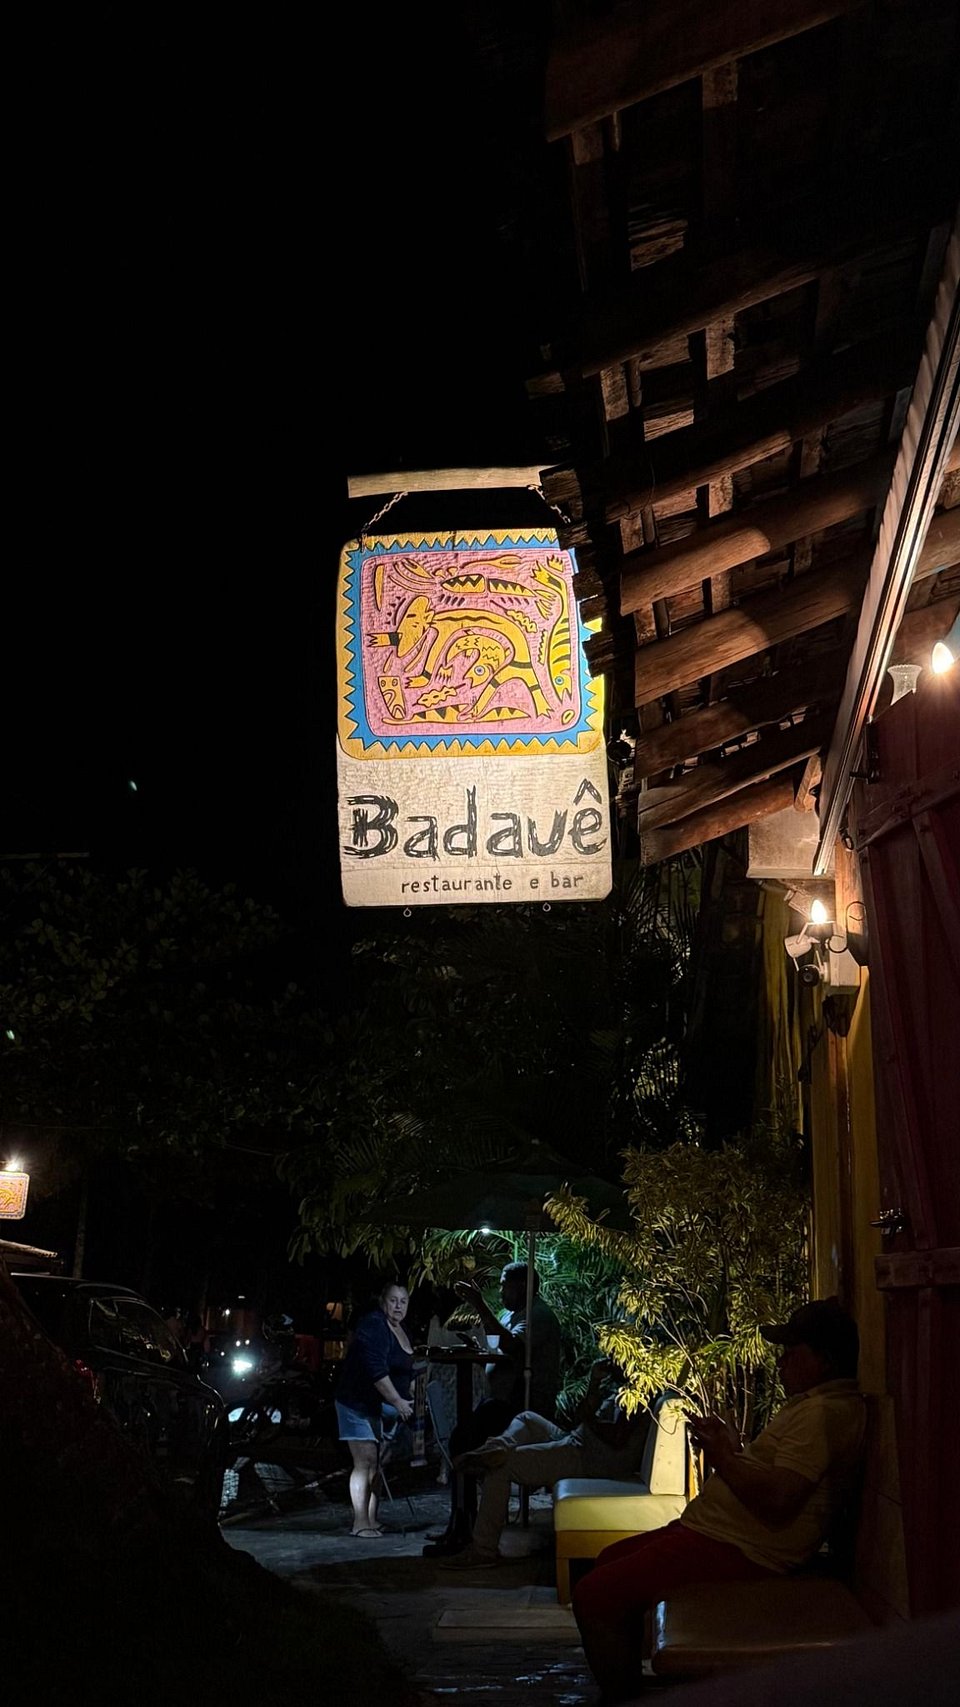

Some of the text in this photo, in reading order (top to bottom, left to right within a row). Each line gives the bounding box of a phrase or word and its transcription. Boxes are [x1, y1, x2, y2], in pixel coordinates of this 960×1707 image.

[401, 871, 584, 893] restaurante e bar
